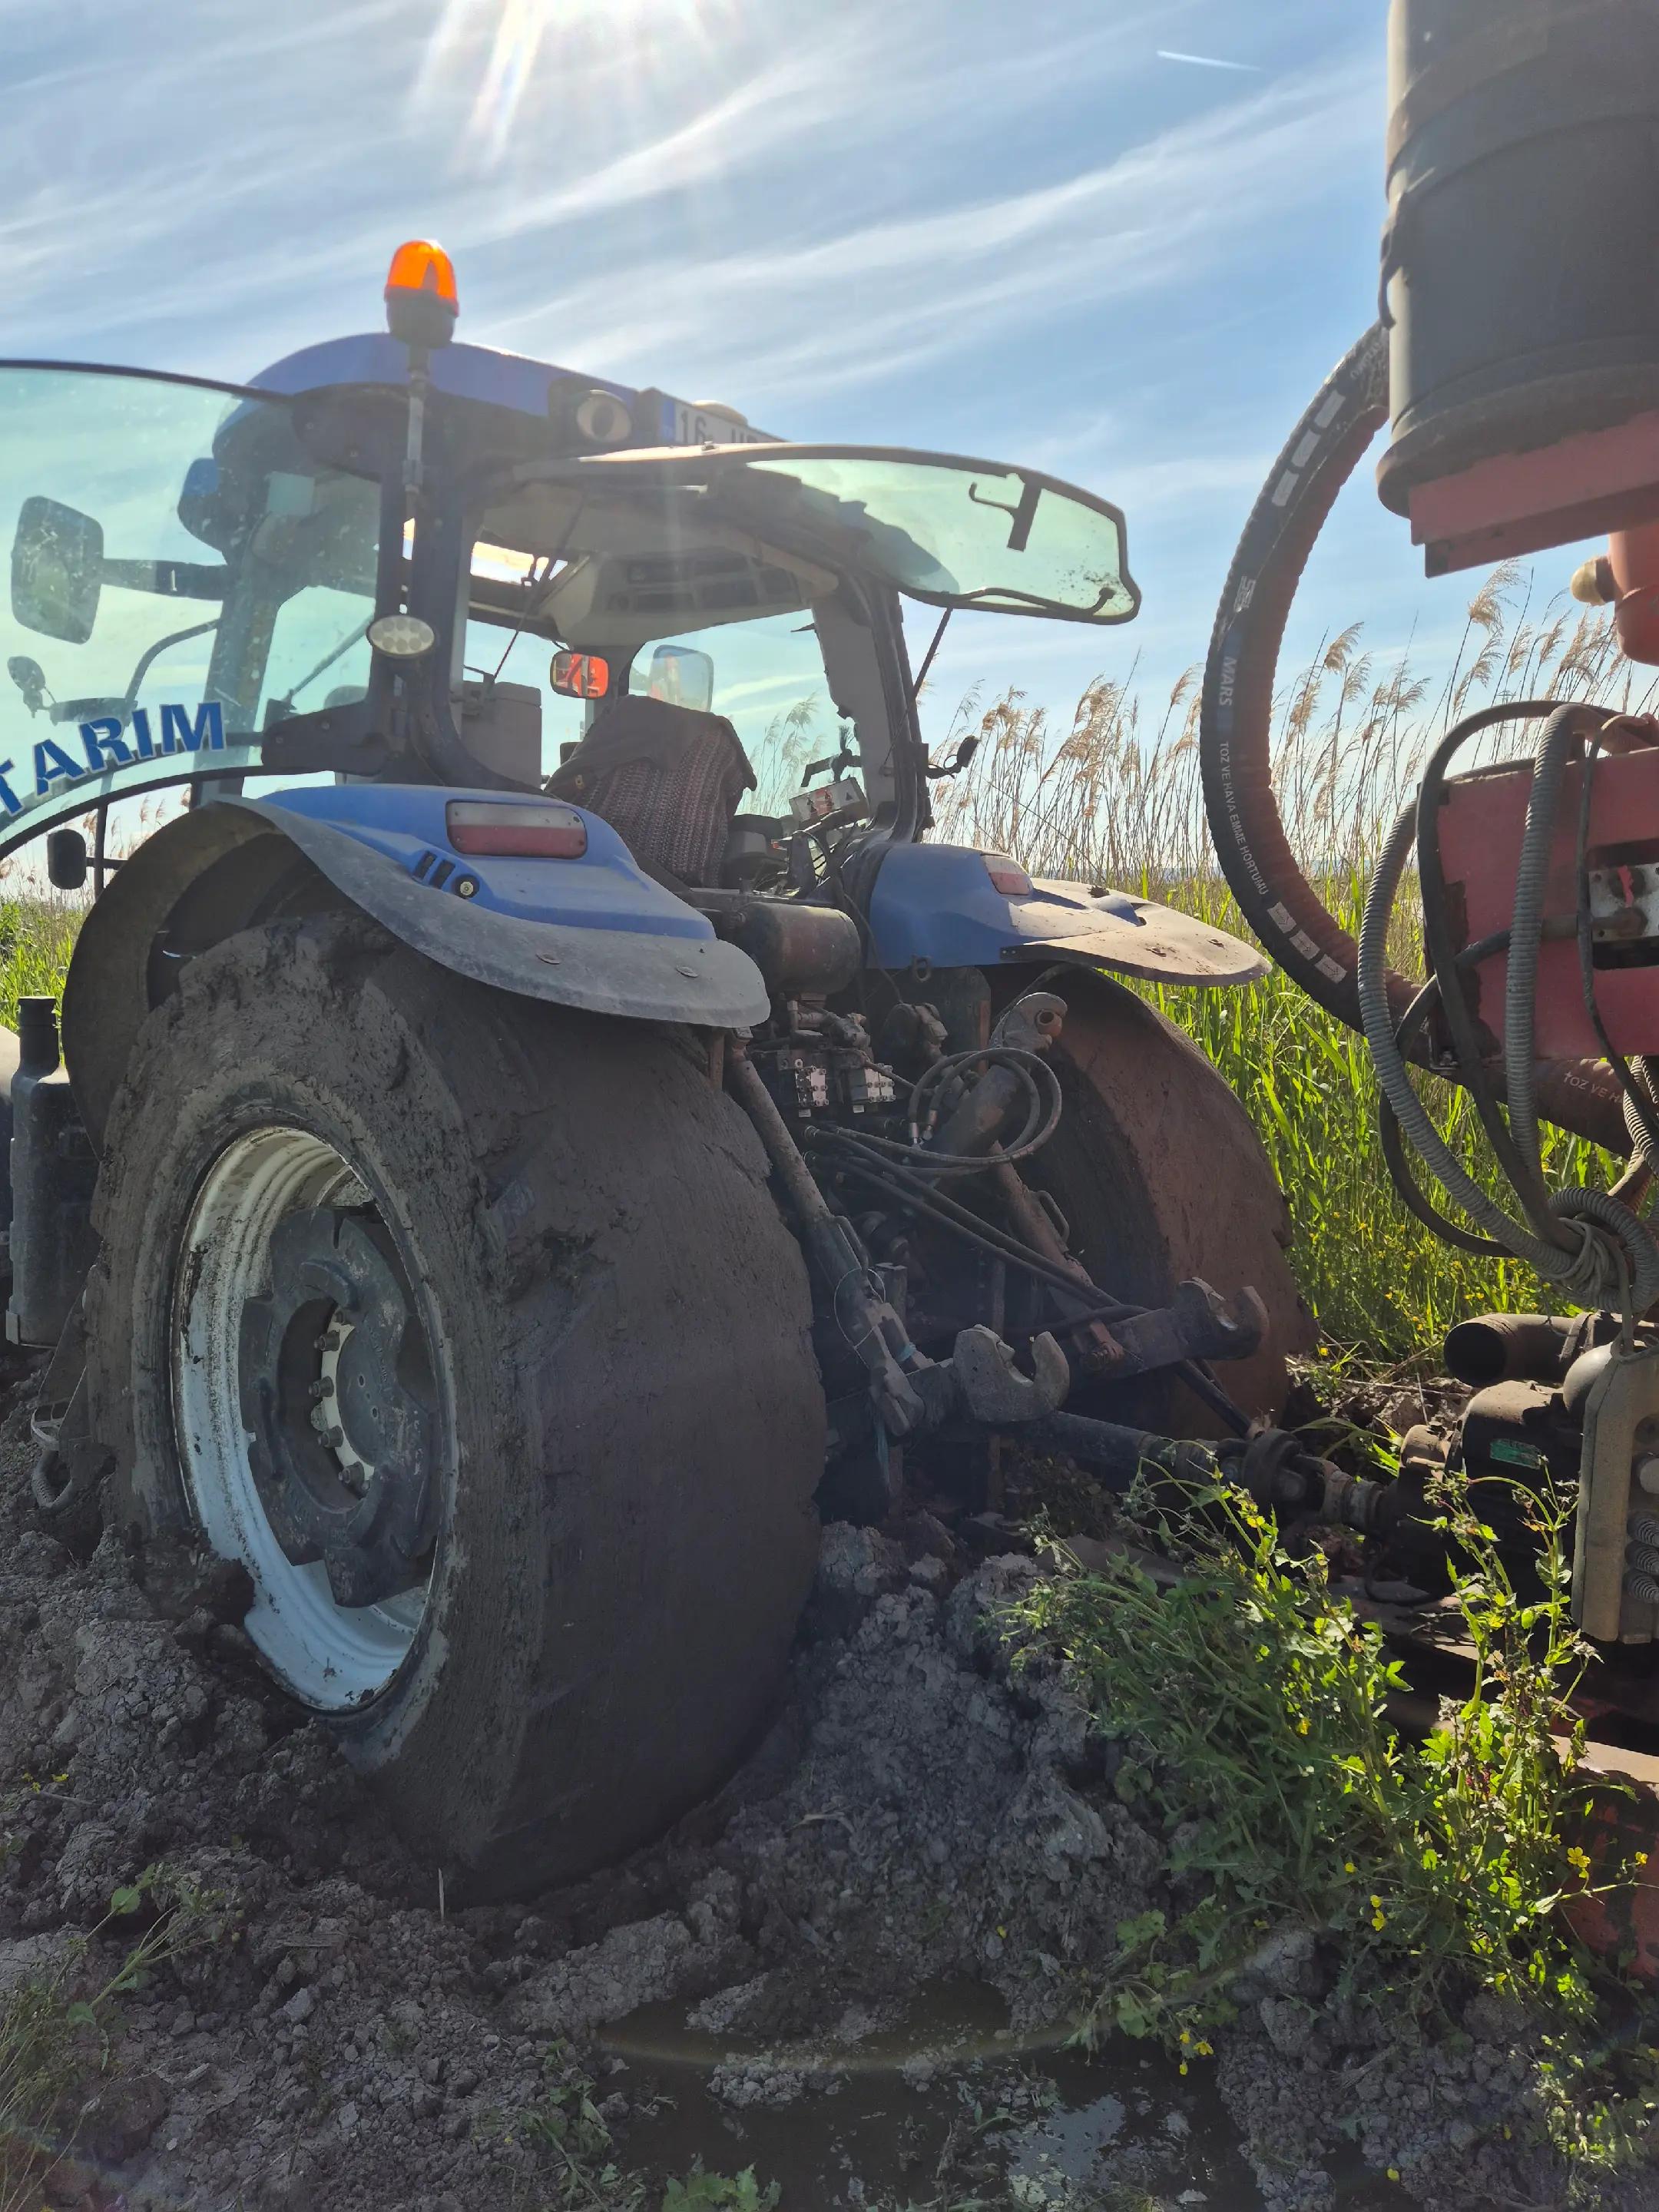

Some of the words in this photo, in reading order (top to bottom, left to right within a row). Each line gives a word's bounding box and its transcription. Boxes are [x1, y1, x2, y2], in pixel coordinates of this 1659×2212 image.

[1219, 656, 1237, 706] MARS
[0, 700, 227, 817] TARIM
[1220, 740, 1230, 763] TOZ
[1221, 765, 1230, 781] VE
[1223, 782, 1236, 813] HAVA
[1229, 813, 1246, 845] EMME
[1239, 846, 1269, 895] HORTUMU
[1563, 1071, 1589, 1090] TOZ
[1591, 1084, 1608, 1098] VE
